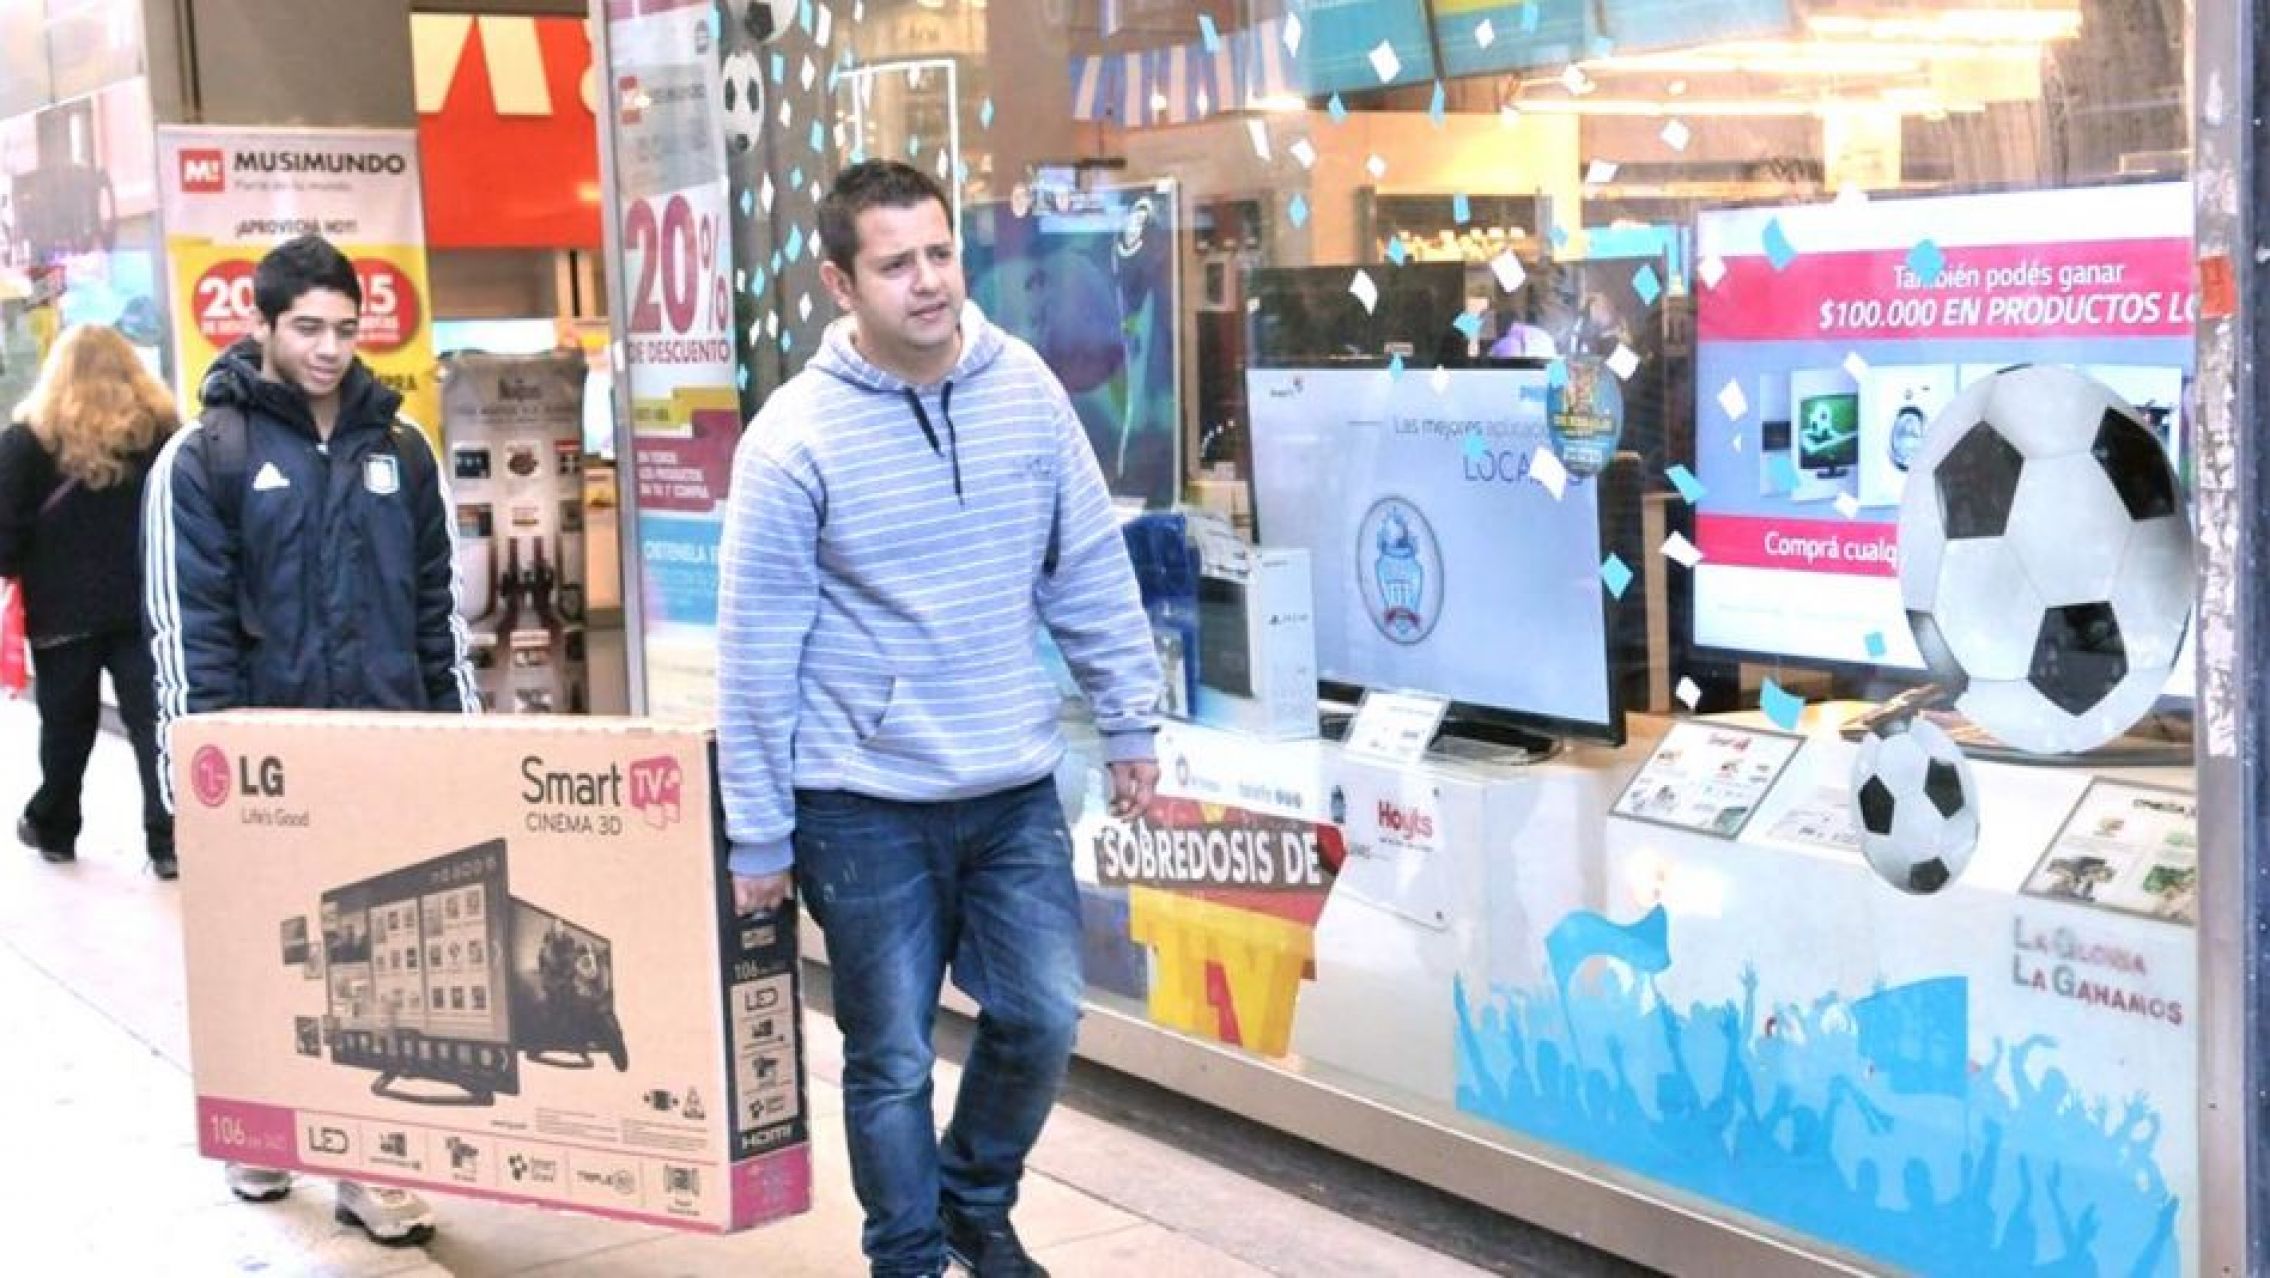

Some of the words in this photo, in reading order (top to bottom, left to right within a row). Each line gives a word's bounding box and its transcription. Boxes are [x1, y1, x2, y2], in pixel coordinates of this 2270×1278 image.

[234, 152, 406, 175] MUSIMUNDO
[625, 193, 728, 334] 20%
[1986, 263, 2052, 291] podés
[2059, 265, 2125, 292] ganar
[1819, 299, 1938, 329] $100.000
[1942, 298, 1979, 325] EN
[1986, 294, 2160, 326] PRODUCTOS
[627, 340, 645, 363] DE
[649, 340, 731, 363] DESCUENTO
[1395, 418, 1419, 434] Las
[1421, 419, 1482, 440] mejores
[1764, 531, 1839, 564] Comprá
[240, 754, 284, 797] LG
[521, 755, 623, 806] Smart
[632, 766, 663, 803] TV
[275, 808, 310, 826] Good
[526, 811, 592, 833] CINEMA
[598, 814, 623, 836] 3D
[1378, 798, 1433, 841] Hoyts
[1104, 825, 1276, 885] SOBREDOSIS
[1281, 830, 1323, 885] DE
[744, 986, 779, 1012] LED
[2052, 964, 2183, 1026] GANAMOS
[210, 1114, 245, 1145] 106
[308, 1126, 350, 1155] LED
